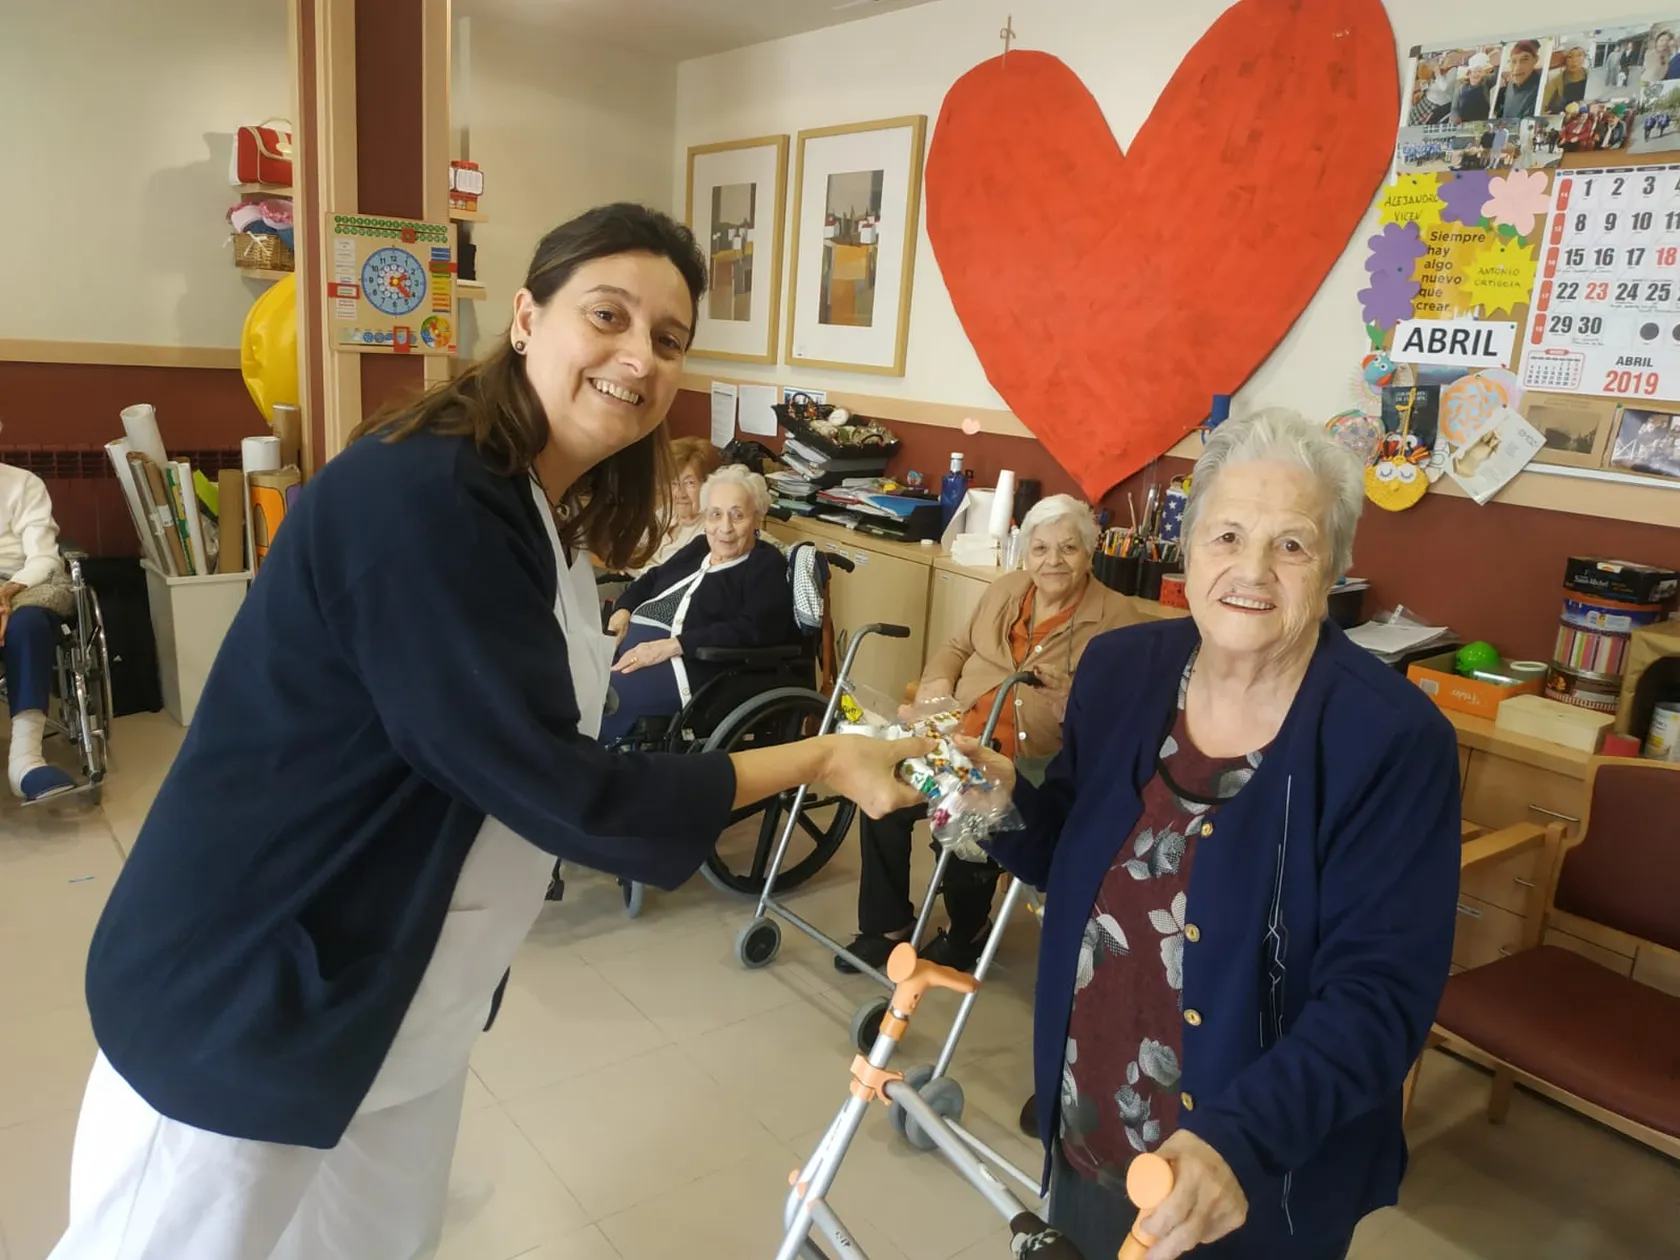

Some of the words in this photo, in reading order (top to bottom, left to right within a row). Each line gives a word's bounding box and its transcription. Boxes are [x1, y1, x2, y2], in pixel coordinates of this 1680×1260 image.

[1585, 179, 1593, 197] 1
[1611, 177, 1625, 196] 2
[1642, 176, 1656, 195] 3
[1575, 213, 1587, 232] 8
[1604, 212, 1617, 231] 9
[1631, 211, 1653, 231] 10
[1430, 231, 1486, 244] Siempre
[1427, 245, 1450, 257] hay
[1565, 248, 1585, 266] 15
[1594, 247, 1615, 266] 16
[1626, 247, 1646, 266] 17
[1656, 247, 1678, 266] 18
[1424, 259, 1453, 271] algo
[1421, 274, 1462, 285] nuevo
[1418, 288, 1443, 297] que
[1556, 282, 1579, 300] 22
[1584, 282, 1609, 300] 23
[1615, 282, 1639, 301] 24
[1645, 283, 1672, 302] 25
[1549, 315, 1573, 334] 29
[1578, 316, 1602, 335] 30
[1402, 327, 1498, 356] ABRIL
[1616, 356, 1654, 368] ABRIL
[1603, 370, 1659, 395] 2019
